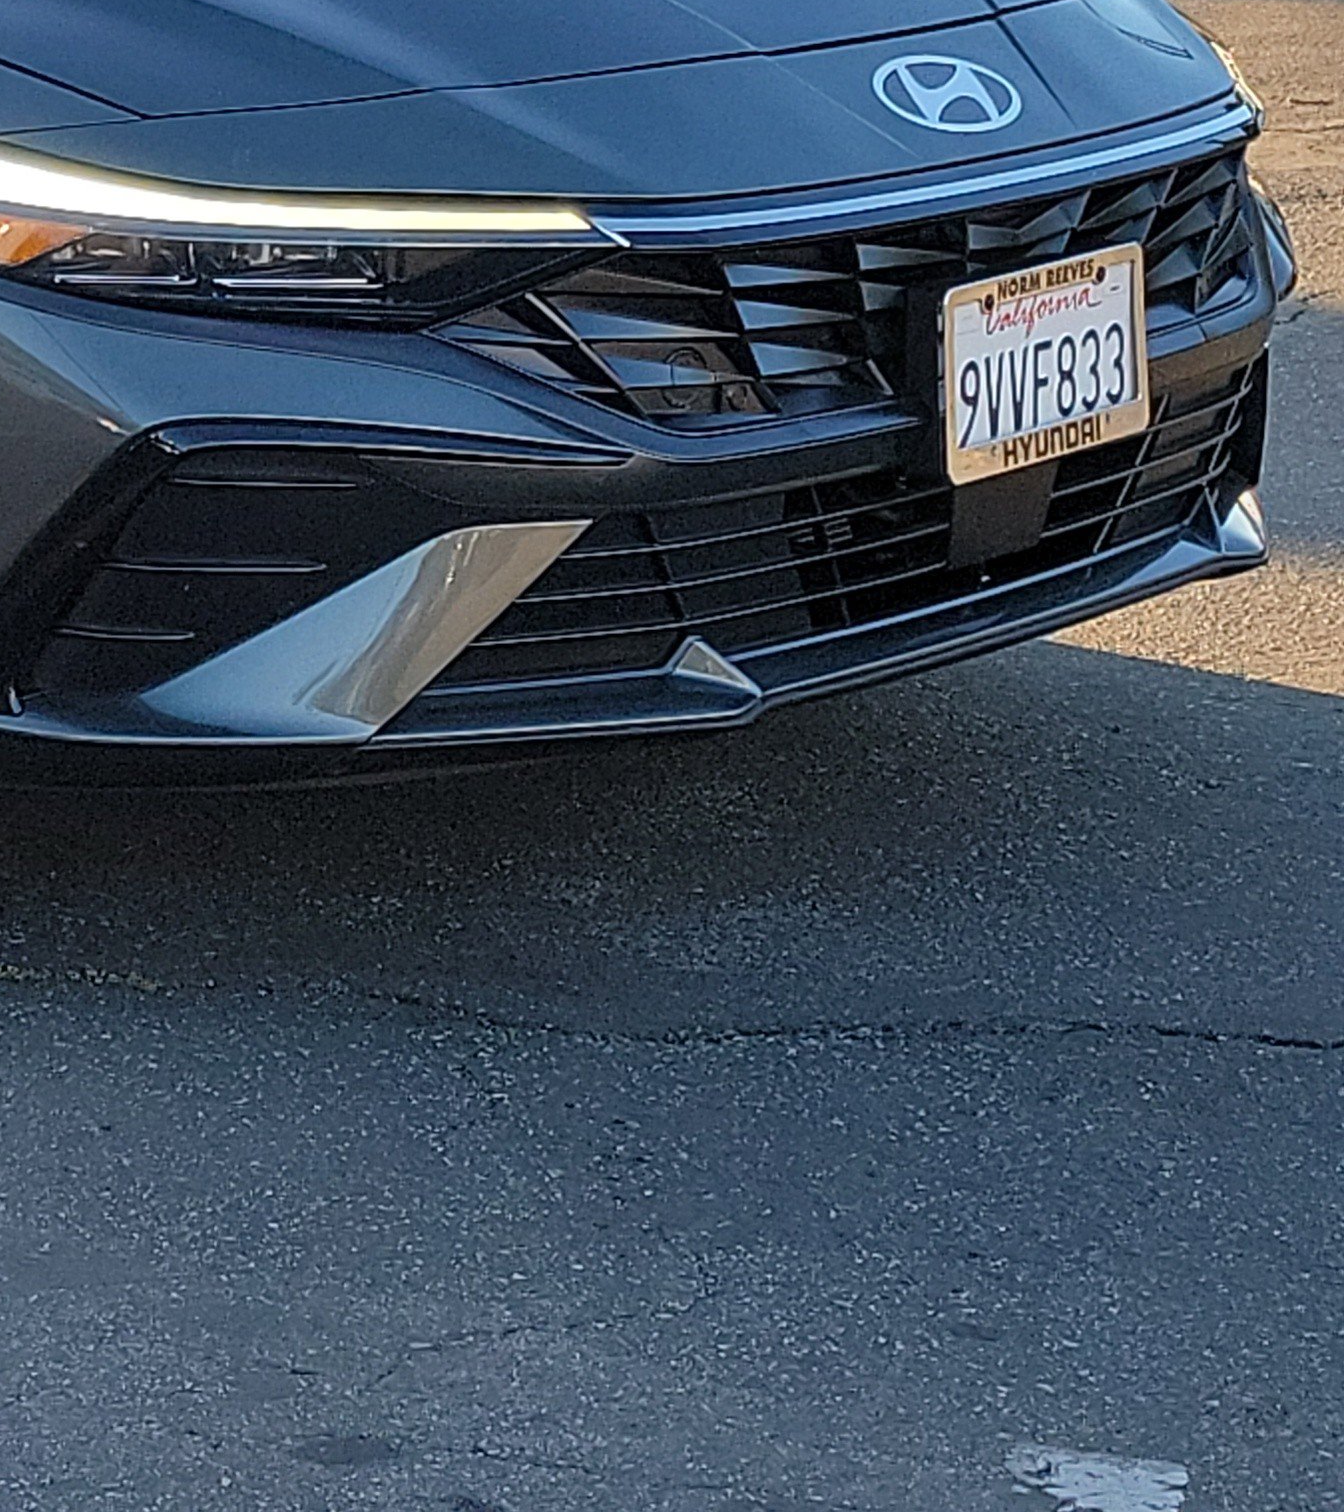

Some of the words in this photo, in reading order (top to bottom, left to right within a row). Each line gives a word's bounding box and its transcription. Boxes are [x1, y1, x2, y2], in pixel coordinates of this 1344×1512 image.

[997, 275, 1041, 301] NORM
[1046, 259, 1094, 286] REEVES
[983, 286, 1102, 338] California
[958, 322, 1125, 449] 9VVF833
[1003, 413, 1101, 468] HYUNDAI
